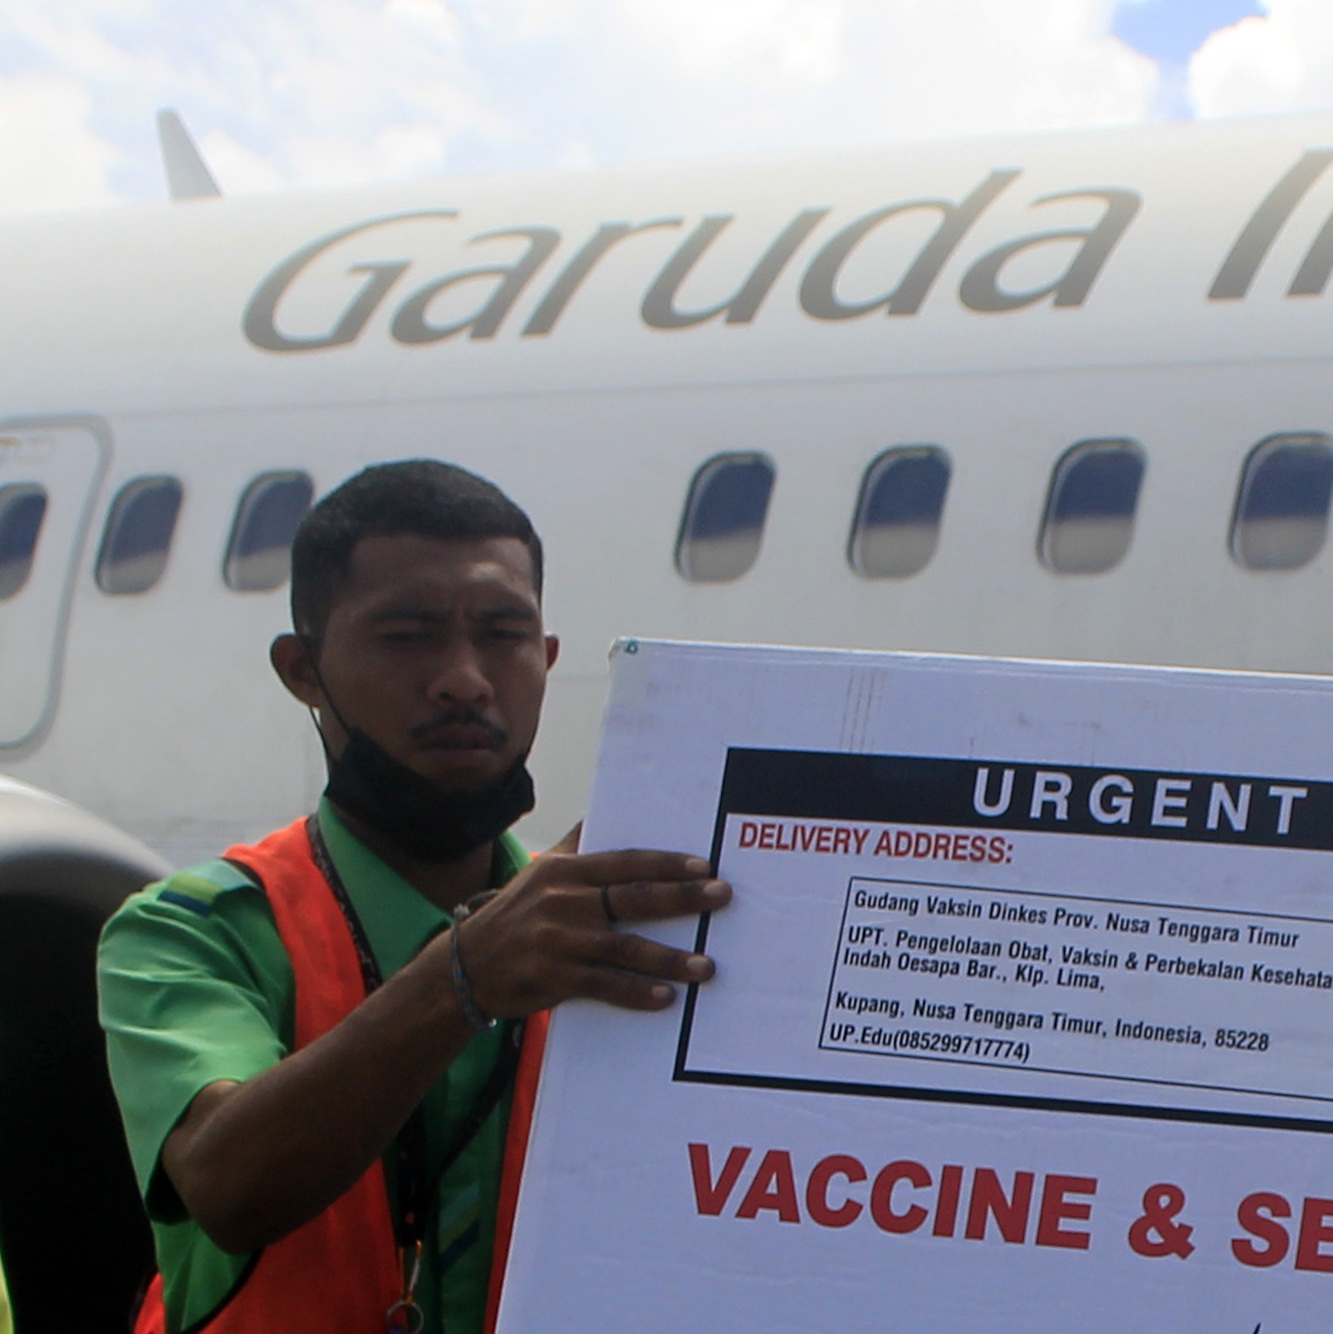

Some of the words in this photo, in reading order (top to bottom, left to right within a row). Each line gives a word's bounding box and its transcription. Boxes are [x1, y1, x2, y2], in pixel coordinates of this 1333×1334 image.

[238, 167, 1141, 353] Garuda
[973, 768, 1308, 834] URGENT
[739, 823, 872, 856] DELIVERY
[873, 830, 1013, 864] ADDRESS:
[855, 890, 919, 916] Gudang
[927, 896, 982, 918] Vaksin
[989, 902, 1047, 924] Dinkes
[1054, 909, 1098, 930] Prov.
[1107, 913, 1149, 934] Nusa
[1158, 917, 1240, 943] Tenggara
[1247, 926, 1300, 948] Timur
[843, 948, 891, 970] Indah
[898, 953, 960, 978] Oesapa
[967, 959, 1008, 983] Bar.,
[1015, 964, 1049, 987] Klp.
[1057, 968, 1105, 992] Lima,
[848, 925, 888, 947] UPT.
[896, 930, 1001, 958] Pengelolaan
[1009, 941, 1053, 964] Obat,
[1062, 947, 1118, 968] Vaksin
[1125, 953, 1138, 971] &
[1145, 954, 1244, 981] Perbekalan
[829, 1023, 1030, 1063] UP.Edu(085299717774)
[835, 991, 905, 1018] Kupang,
[913, 998, 956, 1021] Nusa
[963, 1004, 1044, 1030] Tenggara
[1050, 1012, 1107, 1038] Timur,
[1115, 1018, 1207, 1047] Indonesia,
[1214, 1029, 1270, 1051] 85228
[686, 1142, 1098, 1250] VACCINE
[1127, 1183, 1196, 1260] &
